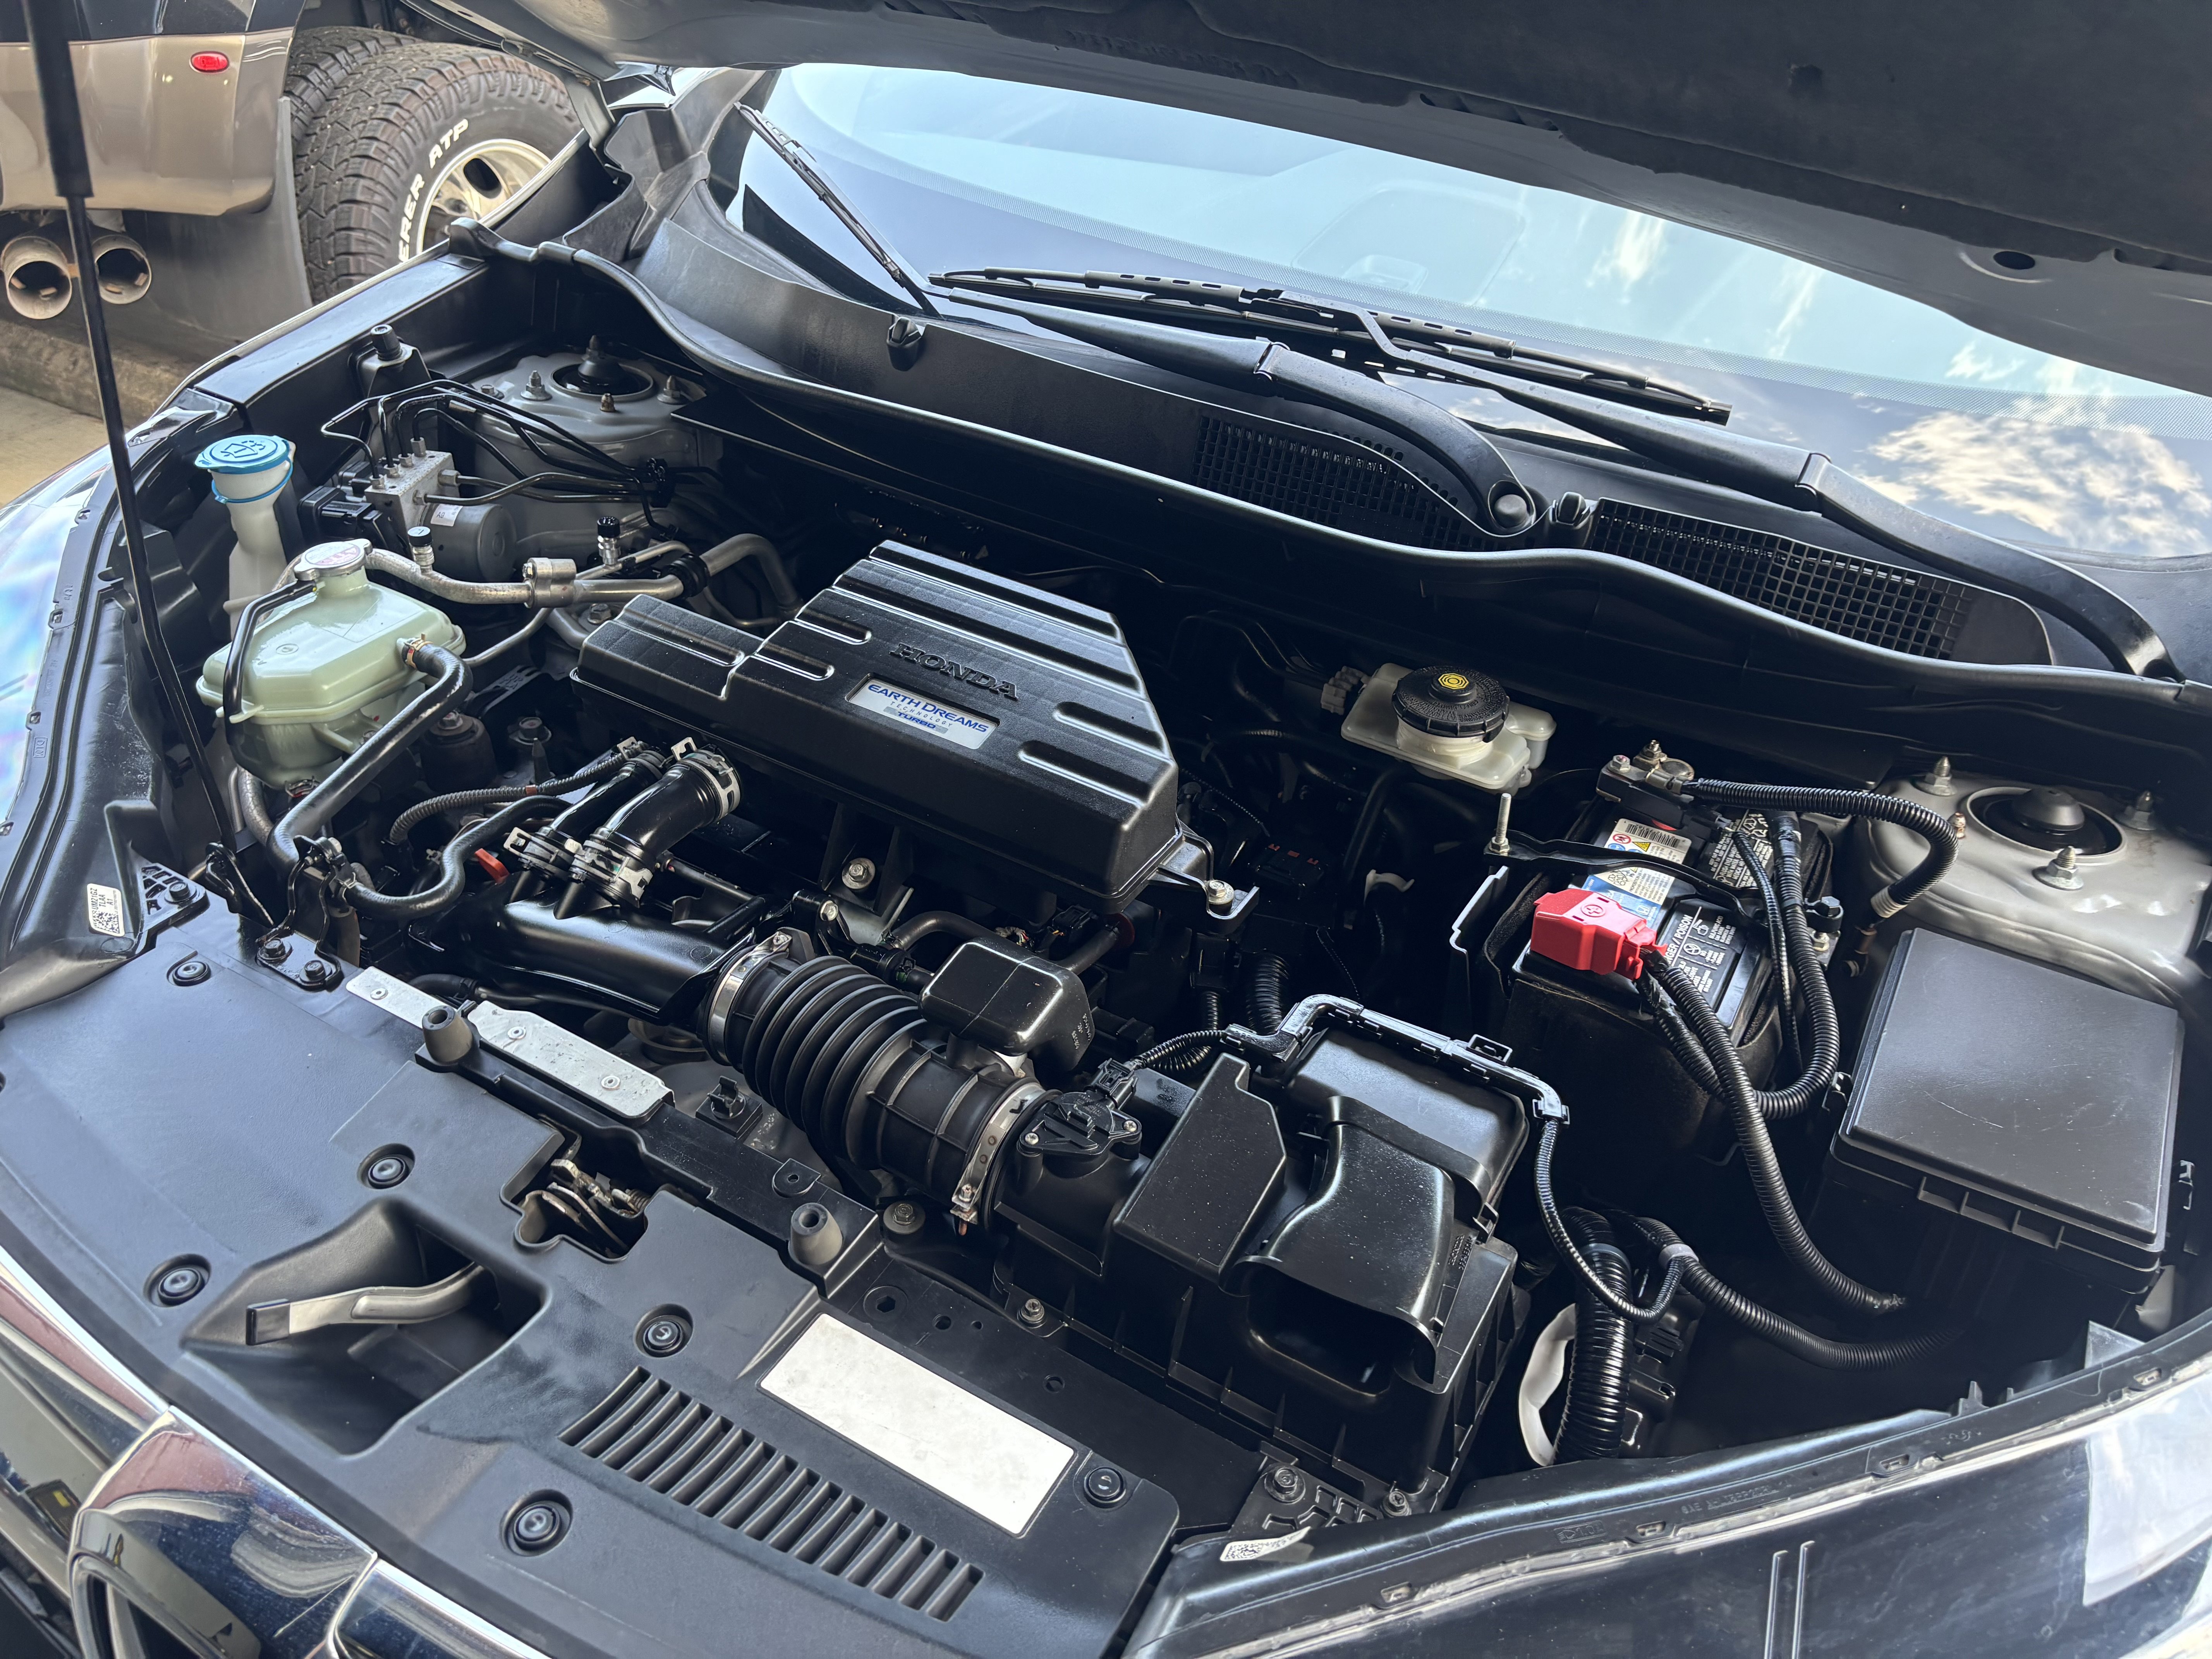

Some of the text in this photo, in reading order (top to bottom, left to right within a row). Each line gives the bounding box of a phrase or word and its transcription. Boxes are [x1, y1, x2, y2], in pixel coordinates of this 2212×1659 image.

[429, 118, 469, 169] ATP
[889, 643, 1018, 701] HONDA
[868, 684, 989, 733] EARTH DREAMS
[891, 701, 953, 727] TECHNOLOGY
[897, 711, 936, 729] TURBO
[1674, 914, 1693, 939] POISON
